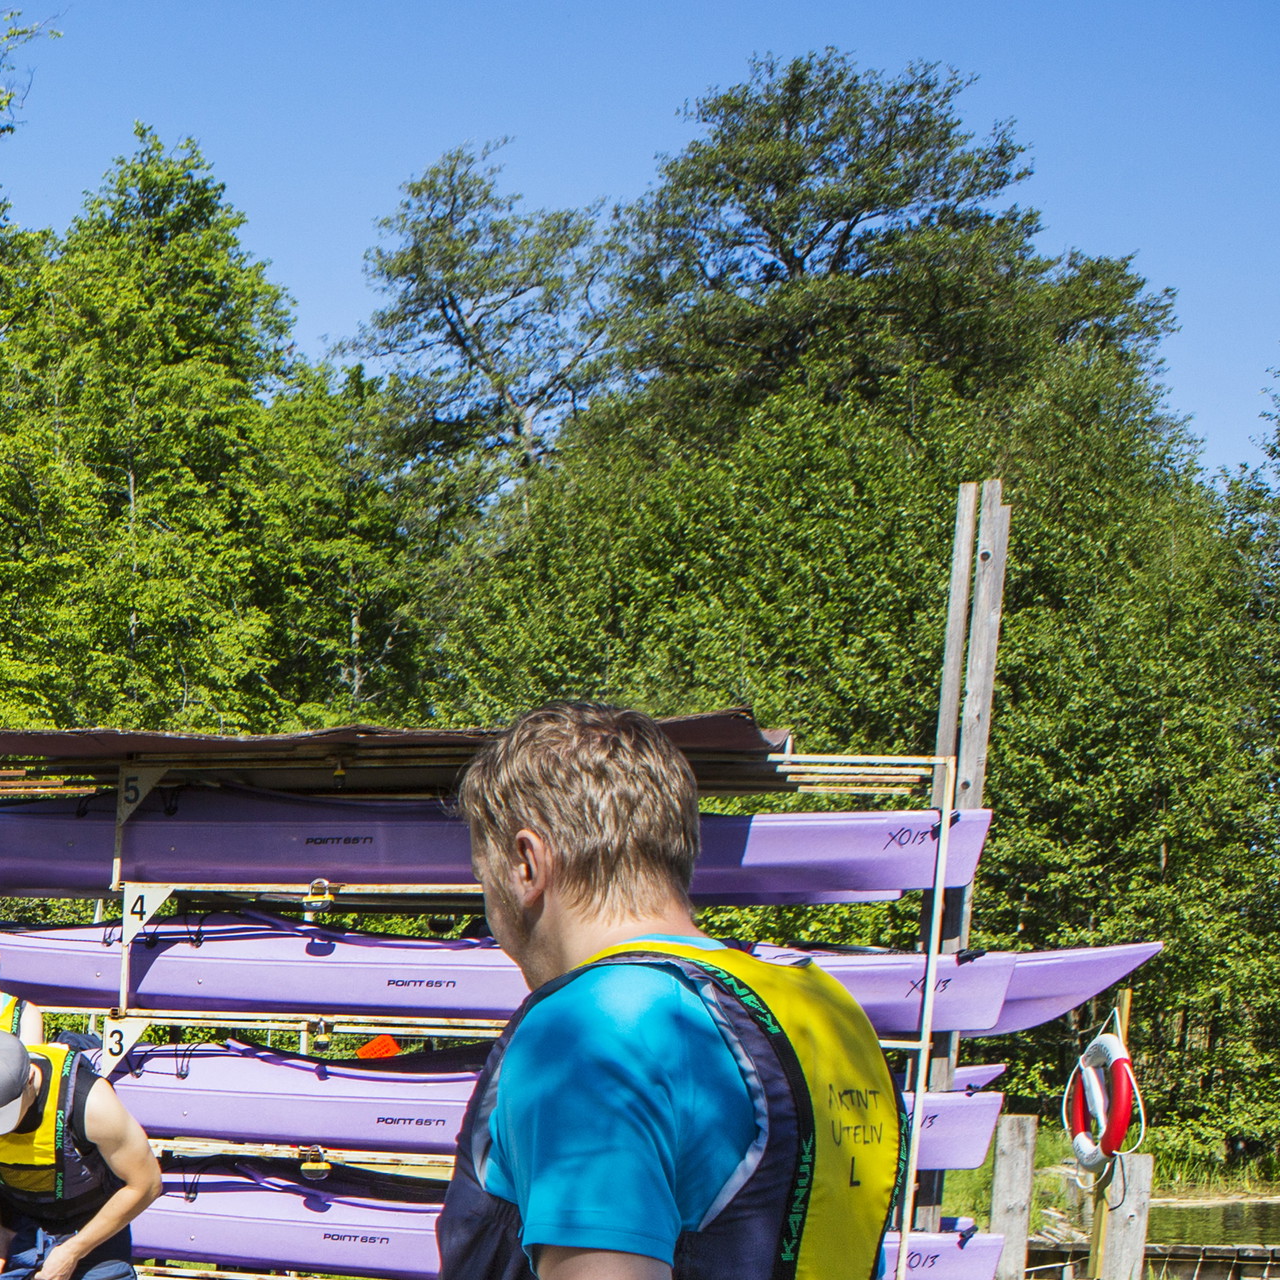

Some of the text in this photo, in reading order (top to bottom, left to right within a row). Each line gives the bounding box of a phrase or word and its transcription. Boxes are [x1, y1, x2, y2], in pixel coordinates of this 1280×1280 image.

[124, 776, 141, 804] 5
[305, 837, 342, 846] POINT
[129, 894, 147, 921] 4
[387, 979, 424, 988] POINT
[107, 1028, 125, 1057] 3
[61, 1050, 75, 1078] KANUK
[55, 1109, 65, 1150] KANUK
[376, 1117, 415, 1126] POINT
[831, 1119, 883, 1147] UTELIV
[849, 1156, 861, 1188] L
[781, 1131, 814, 1262] KANUK
[323, 1233, 359, 1243] POINT
